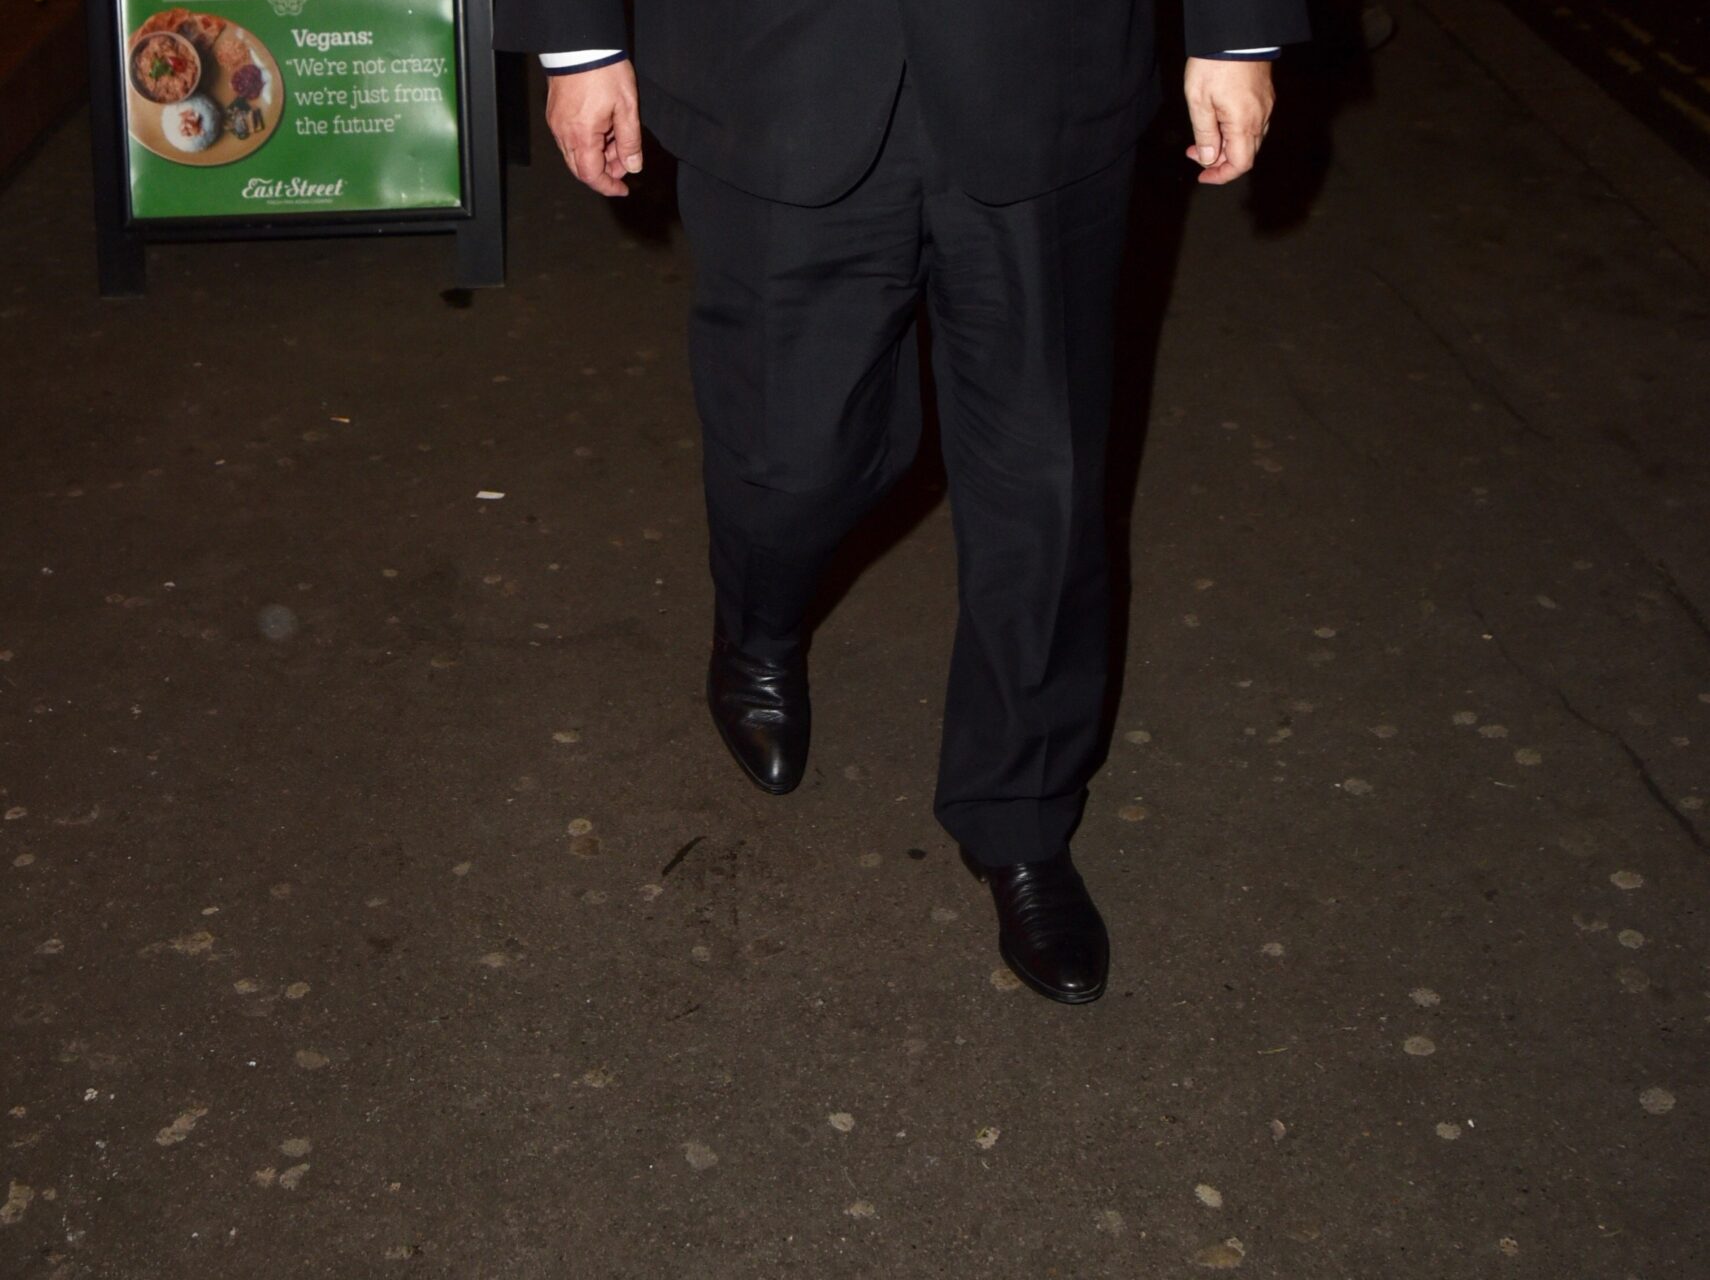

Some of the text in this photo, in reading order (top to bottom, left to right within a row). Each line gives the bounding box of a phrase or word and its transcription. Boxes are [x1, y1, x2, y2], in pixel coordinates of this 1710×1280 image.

[291, 28, 374, 52] Vegans:
[286, 57, 348, 77] “We’re
[352, 57, 387, 75] not
[294, 83, 443, 110] we’re just from
[296, 114, 402, 135] the future”
[241, 176, 343, 199] East Street
